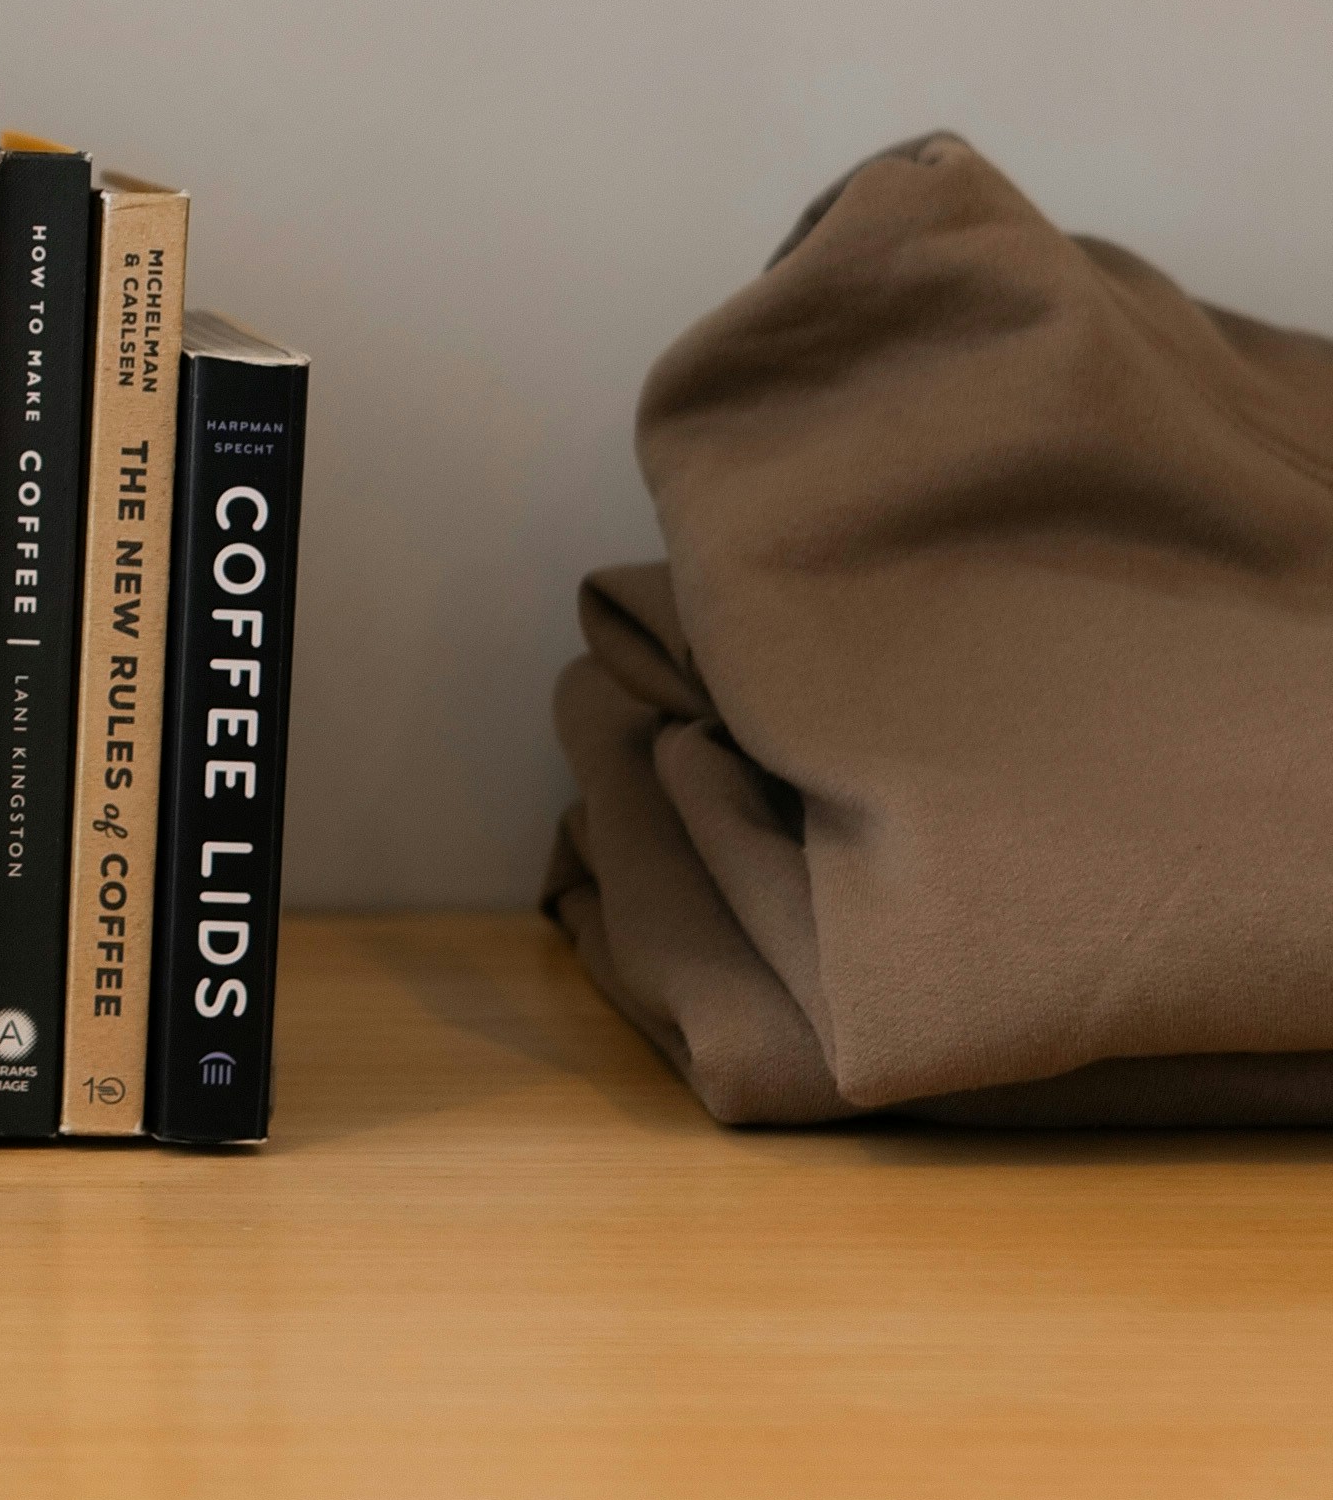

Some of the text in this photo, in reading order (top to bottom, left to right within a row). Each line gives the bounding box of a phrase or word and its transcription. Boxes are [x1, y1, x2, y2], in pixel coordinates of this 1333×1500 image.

[118, 253, 141, 387] & CARLSEN
[143, 249, 164, 393] MICHELMAN
[14, 225, 47, 614] HOW TO MAKE COFFEE
[206, 420, 284, 434] HARPMAN
[214, 442, 275, 455] SPECHT
[7, 675, 29, 877] LANI KINGSTON
[92, 440, 149, 1018] THE NEW RULES of COFFEE
[194, 486, 269, 1019] COFFEE LIDS
